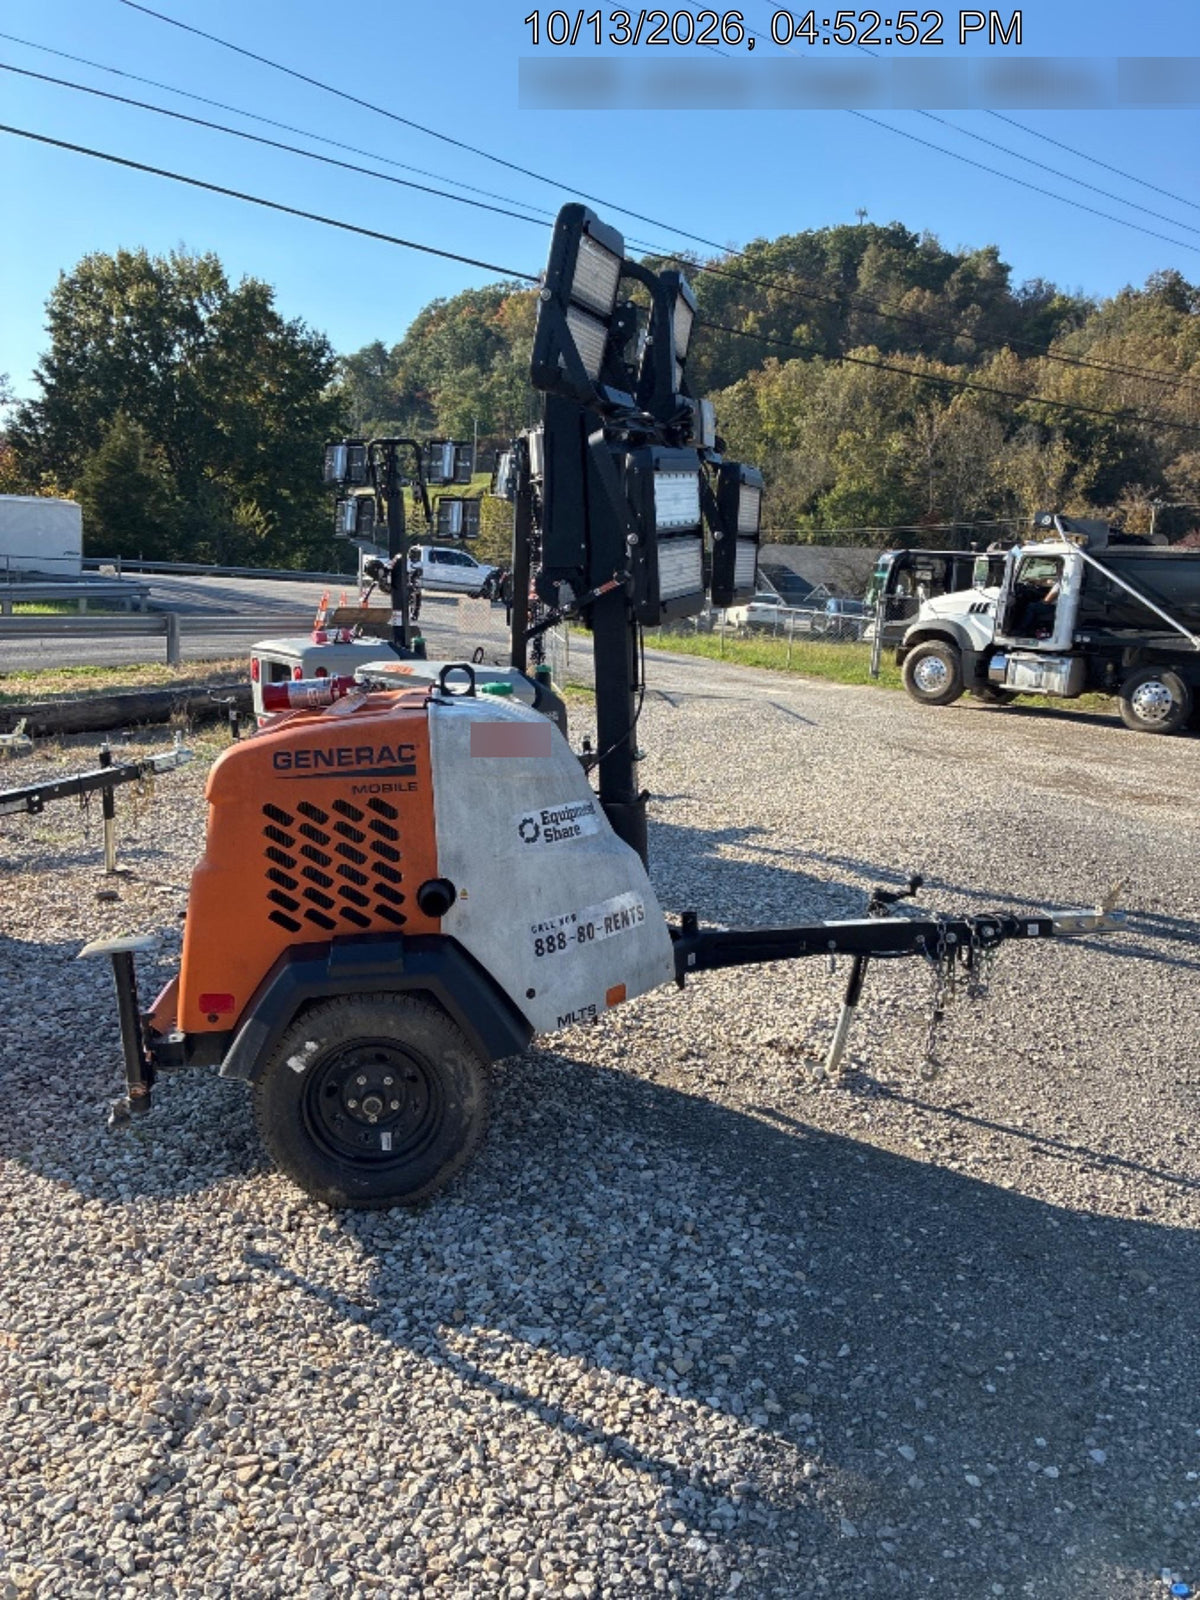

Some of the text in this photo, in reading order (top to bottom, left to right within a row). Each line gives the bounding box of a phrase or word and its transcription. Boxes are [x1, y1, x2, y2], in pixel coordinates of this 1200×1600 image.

[273, 744, 416, 770] GENERAC
[351, 781, 418, 795] MOBILE
[540, 801, 596, 826] Equipmt
[543, 824, 582, 843] Share
[531, 921, 556, 935] CALL
[534, 904, 645, 958] 888-80-RENTS
[557, 1003, 597, 1028] MLTS
